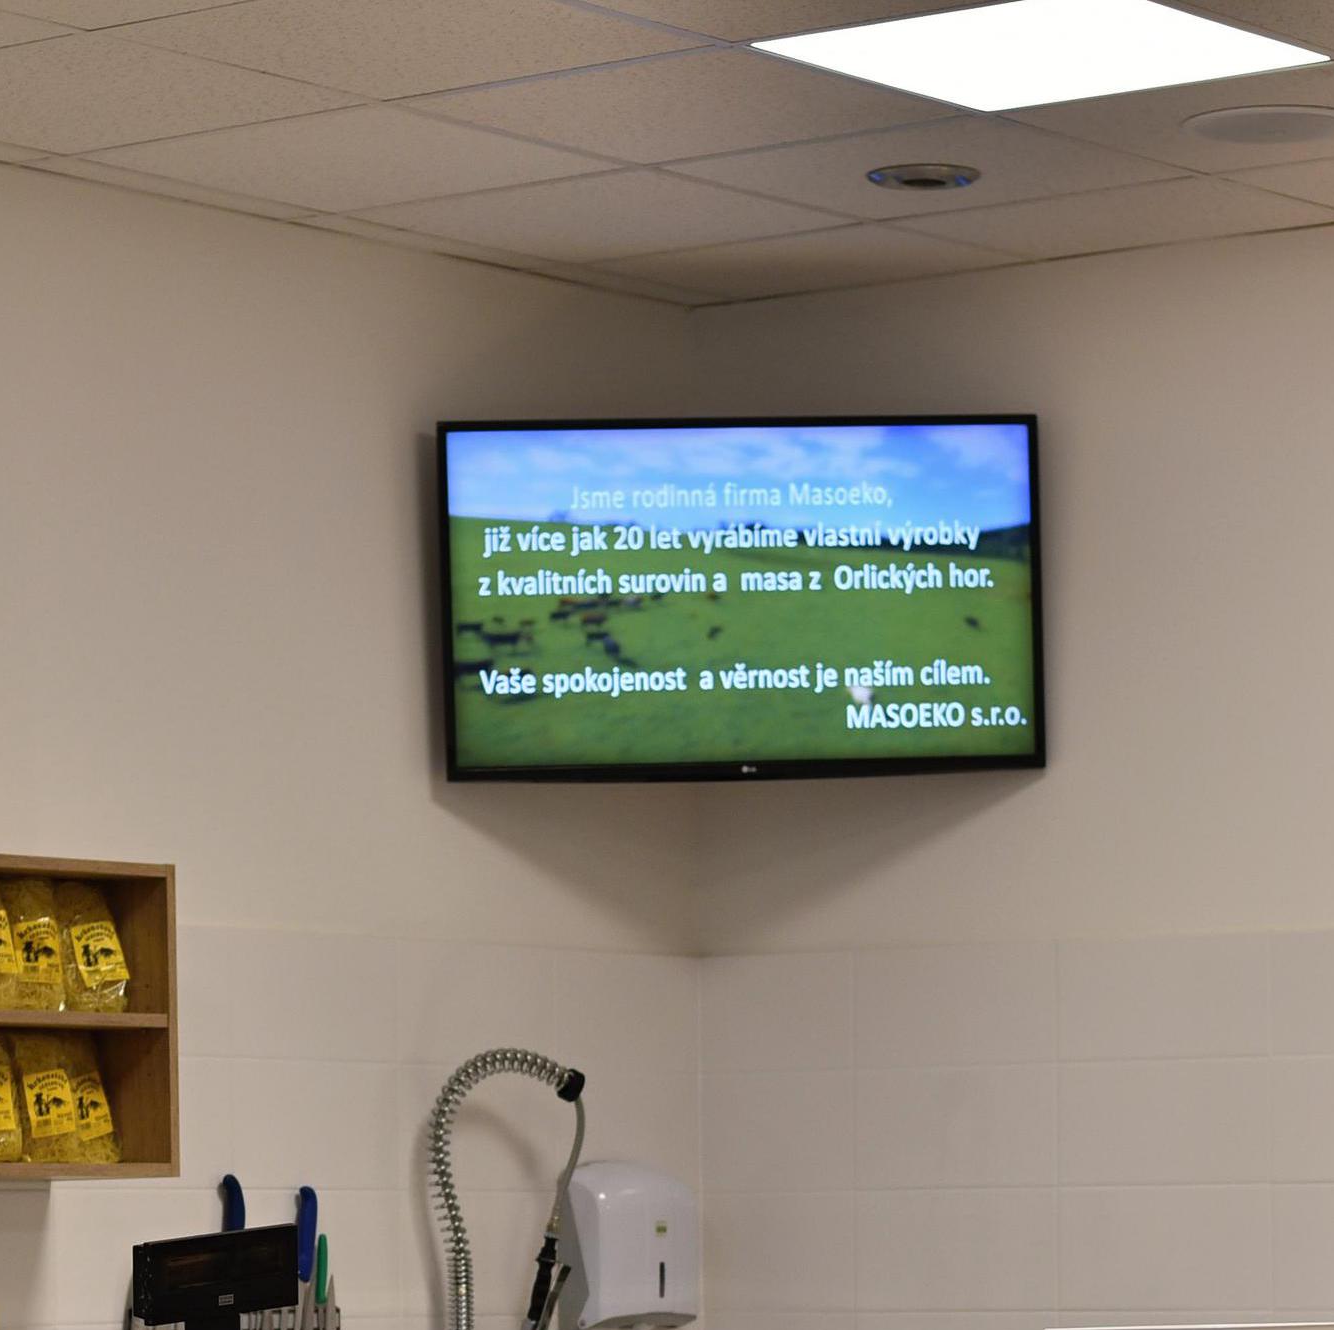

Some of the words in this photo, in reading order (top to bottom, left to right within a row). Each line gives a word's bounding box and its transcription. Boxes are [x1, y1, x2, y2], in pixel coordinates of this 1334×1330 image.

[570, 485, 624, 509] Jsme
[632, 482, 716, 509] rodinná
[723, 481, 782, 507] firma
[788, 480, 893, 508] Masoeko,
[482, 525, 512, 558] již
[516, 525, 566, 551] více
[570, 525, 608, 557] jak
[613, 525, 644, 551] 20
[649, 524, 682, 550] let
[687, 522, 798, 554] vyrábíme
[803, 521, 882, 548] vlastní
[887, 519, 980, 551] výrobky
[478, 576, 492, 597] z
[497, 568, 613, 596] kvalitních
[618, 567, 707, 594] surovin
[712, 572, 728, 593] a
[740, 570, 803, 592] masa
[808, 571, 822, 591] z
[833, 562, 943, 595] Orlických
[949, 562, 994, 589] hor.
[479, 667, 537, 695] Vaše
[542, 665, 687, 699] spokojenost
[699, 670, 714, 691] a
[719, 662, 811, 690] věrnost
[814, 662, 839, 694] je
[844, 659, 914, 688] naším
[919, 658, 991, 686] cílem.
[846, 702, 966, 729] MASOEKO
[970, 704, 1028, 728] s.r.o.
